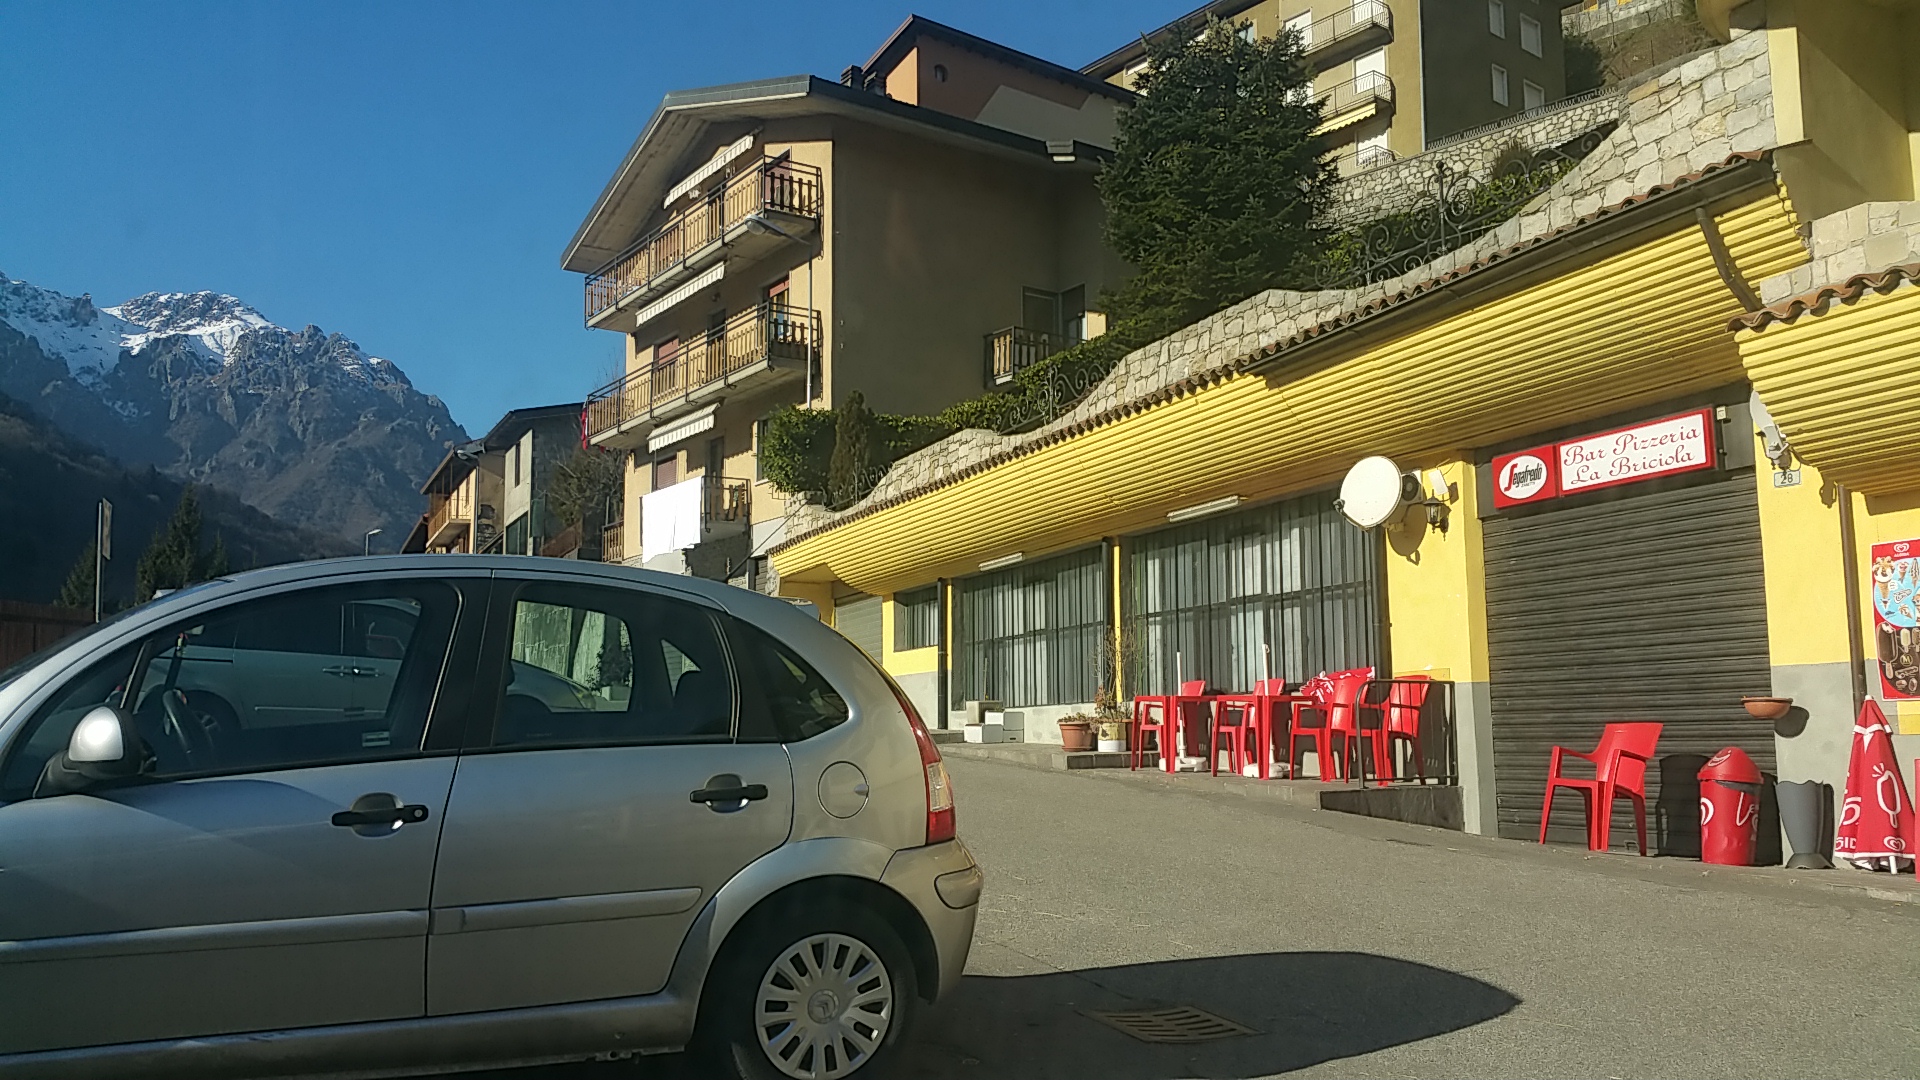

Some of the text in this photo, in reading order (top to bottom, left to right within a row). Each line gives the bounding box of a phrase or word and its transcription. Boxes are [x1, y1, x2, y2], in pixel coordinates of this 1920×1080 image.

[1564, 426, 1700, 466] Bar Pizzeria
[1504, 462, 1542, 492] Segafredo
[1570, 444, 1695, 485] La Briciola
[1780, 472, 1793, 484] 28
